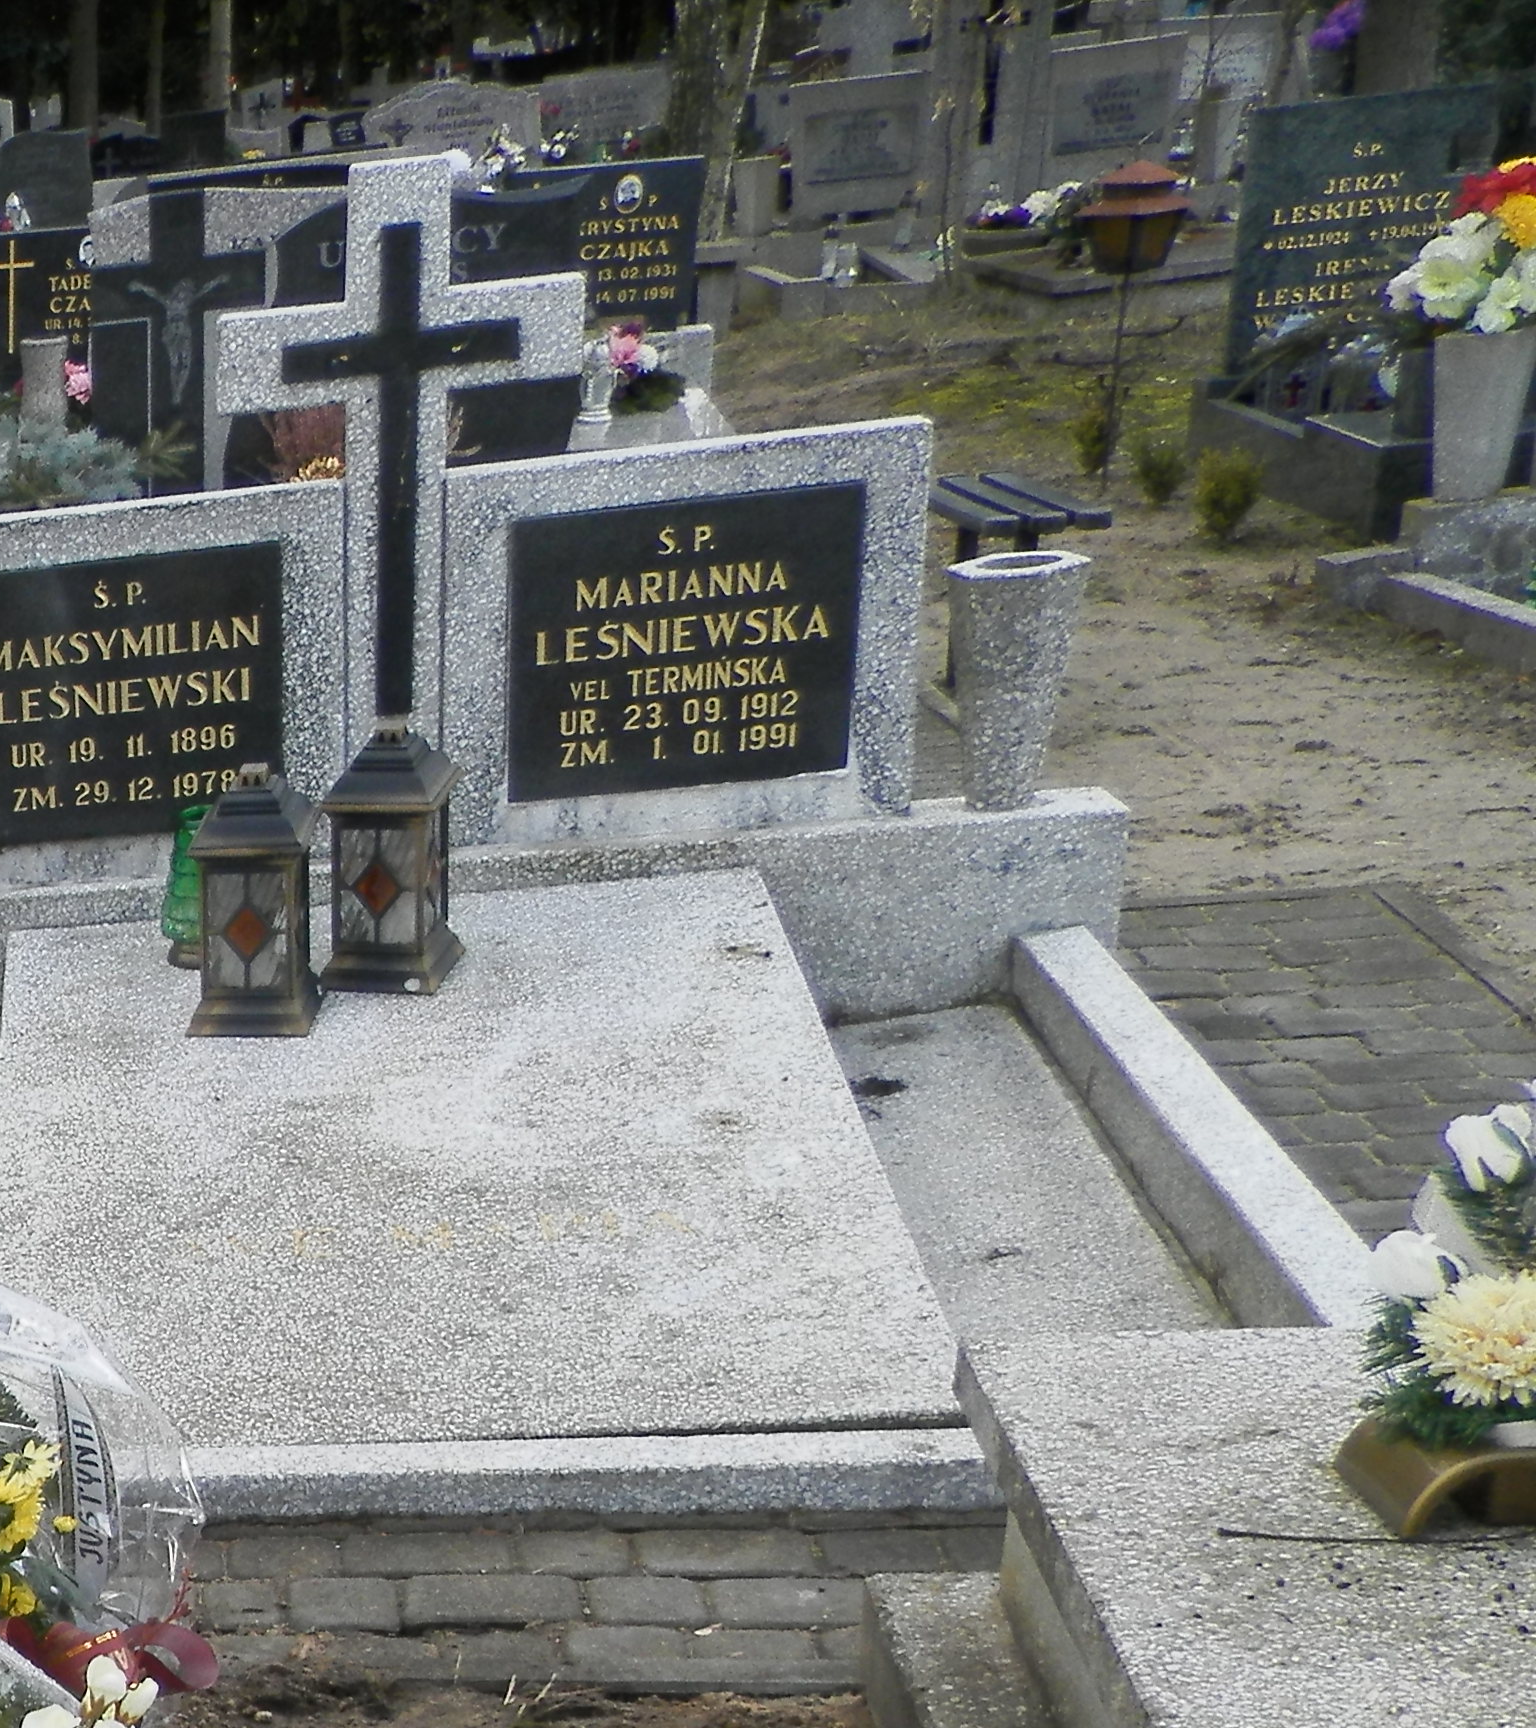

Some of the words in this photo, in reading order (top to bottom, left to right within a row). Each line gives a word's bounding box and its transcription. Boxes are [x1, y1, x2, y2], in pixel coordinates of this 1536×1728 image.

[1324, 171, 1404, 195] JERZY
[1272, 191, 1451, 226] LESKIEWICZ
[580, 239, 670, 261] CZAJKA
[1278, 230, 1352, 251] 02.12.1924
[646, 264, 677, 278] 1931
[49, 297, 92, 314] CZA
[644, 286, 676, 301] 1991
[575, 560, 788, 612] MARIANNA
[535, 604, 829, 666] LEŚNIEWSKA
[569, 679, 610, 702] VEL
[626, 656, 786, 698] TERMIŃSKA
[559, 711, 605, 738] UR.
[622, 705, 669, 732] 23.
[682, 698, 728, 726] 09.
[739, 690, 799, 721] 1912
[11, 742, 53, 769] UR.
[68, 737, 104, 765] 19.
[126, 734, 152, 759] 11.
[170, 724, 236, 754] 1896
[560, 743, 615, 768] ZM.
[652, 735, 667, 761] 1.
[692, 731, 725, 755] 01.
[738, 723, 798, 752] 1991
[12, 786, 64, 813] ZM.
[74, 780, 117, 807] 29.
[127, 777, 162, 802] 12.
[172, 769, 237, 797] 1978
[71, 1418, 104, 1565] JUSTYNA
